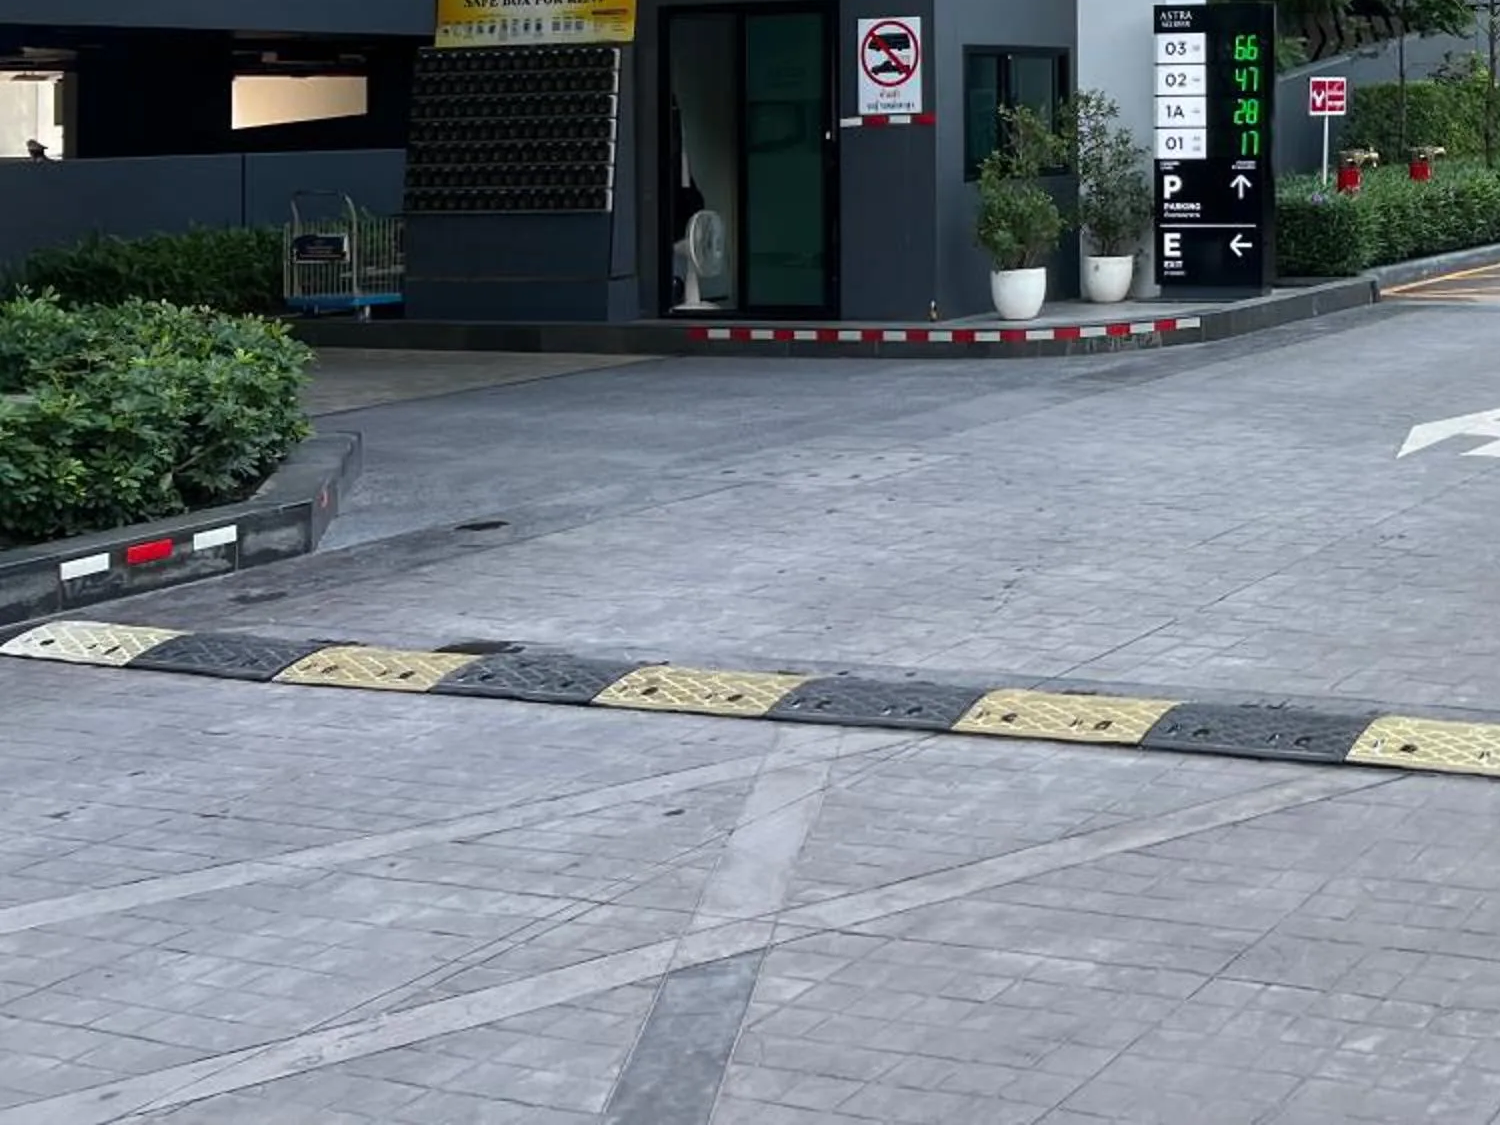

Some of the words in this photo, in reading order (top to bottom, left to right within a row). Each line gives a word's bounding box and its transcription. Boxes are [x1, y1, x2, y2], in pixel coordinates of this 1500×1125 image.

[1160, 10, 1193, 20] ASTRA
[1165, 41, 1187, 55] 03
[1234, 34, 1258, 60] 66
[1165, 73, 1187, 87] 02
[1235, 67, 1258, 91] 47
[1166, 105, 1185, 118] 1A
[1233, 98, 1258, 125] 28
[1165, 136, 1184, 150] 01
[1241, 130, 1259, 155] 17
[1163, 174, 1182, 199] P
[1163, 232, 1182, 257] E
